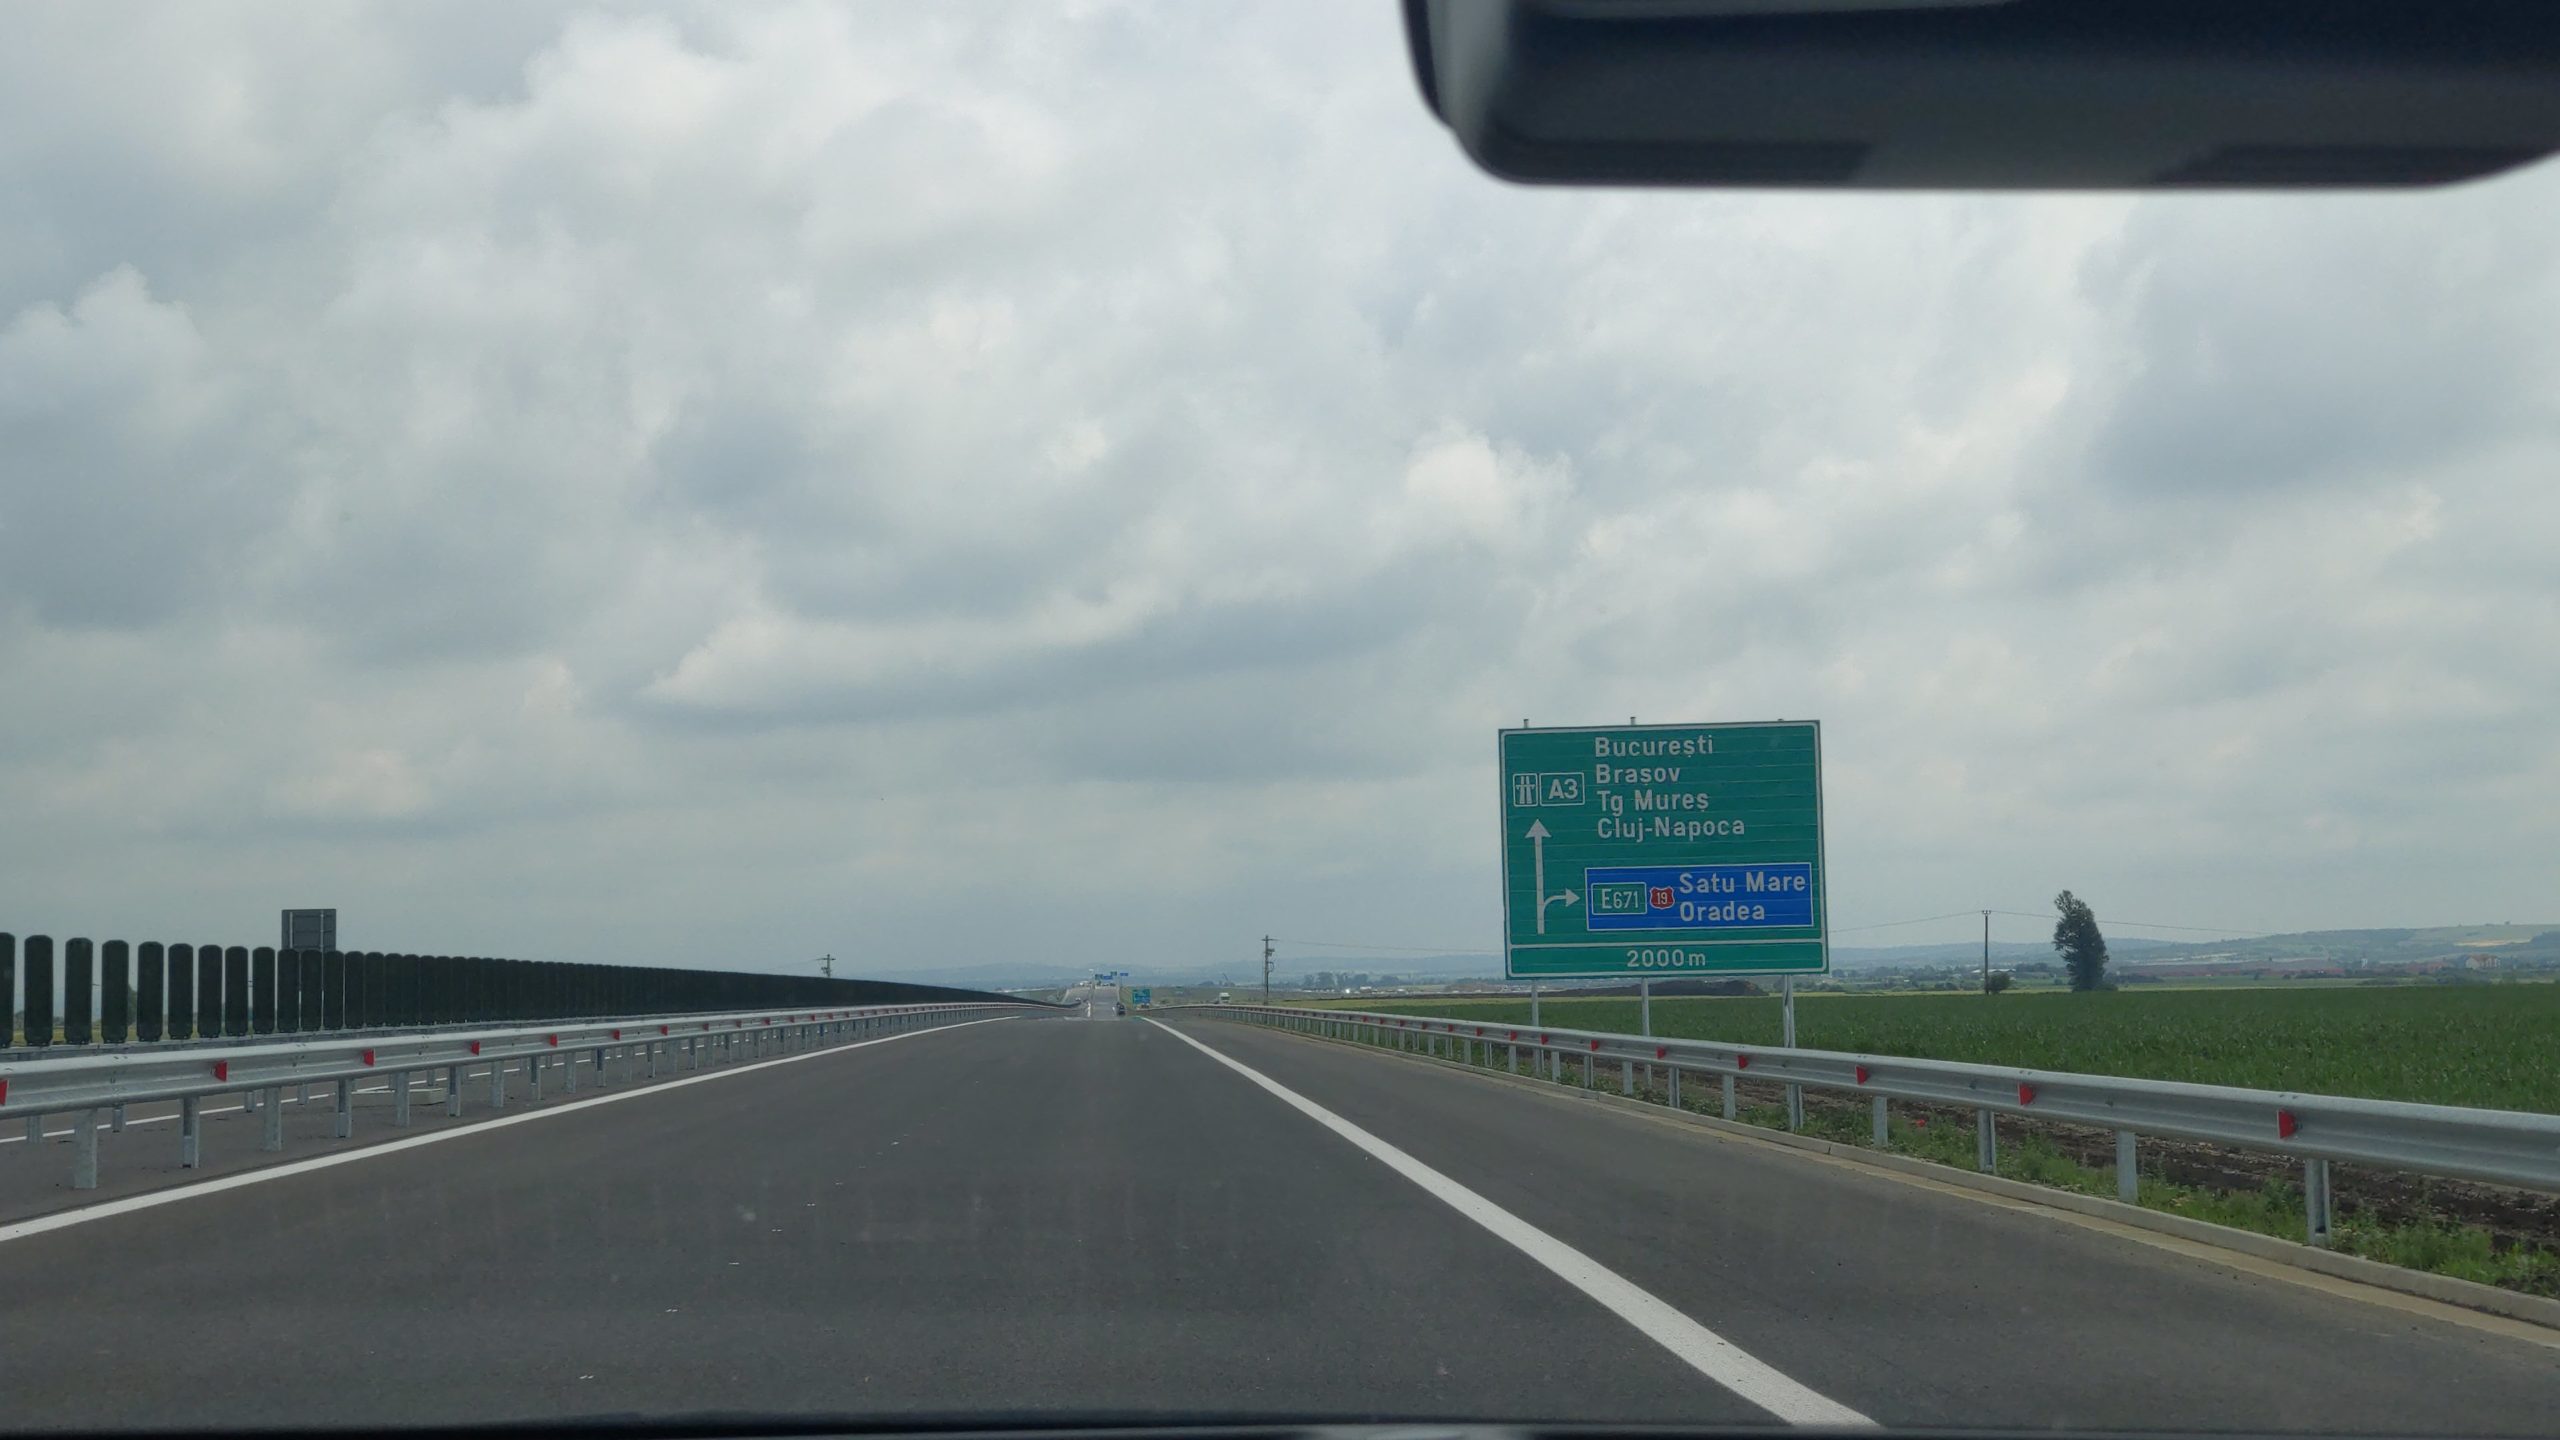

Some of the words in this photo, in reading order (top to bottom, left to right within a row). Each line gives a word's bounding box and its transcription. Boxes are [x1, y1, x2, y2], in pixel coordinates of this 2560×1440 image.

[1595, 735, 1713, 758] București
[1596, 764, 1681, 786] Brașov
[1549, 778, 1579, 800] A3
[1597, 790, 1624, 817] Tg
[1634, 790, 1710, 813] Mureș
[1597, 817, 1745, 843] Cluj-Napoca
[1679, 872, 1735, 894] Satu
[1746, 871, 1806, 893] Mare
[1602, 887, 1639, 909] E671
[1656, 892, 1669, 905] 19
[1680, 901, 1765, 922] Oradea
